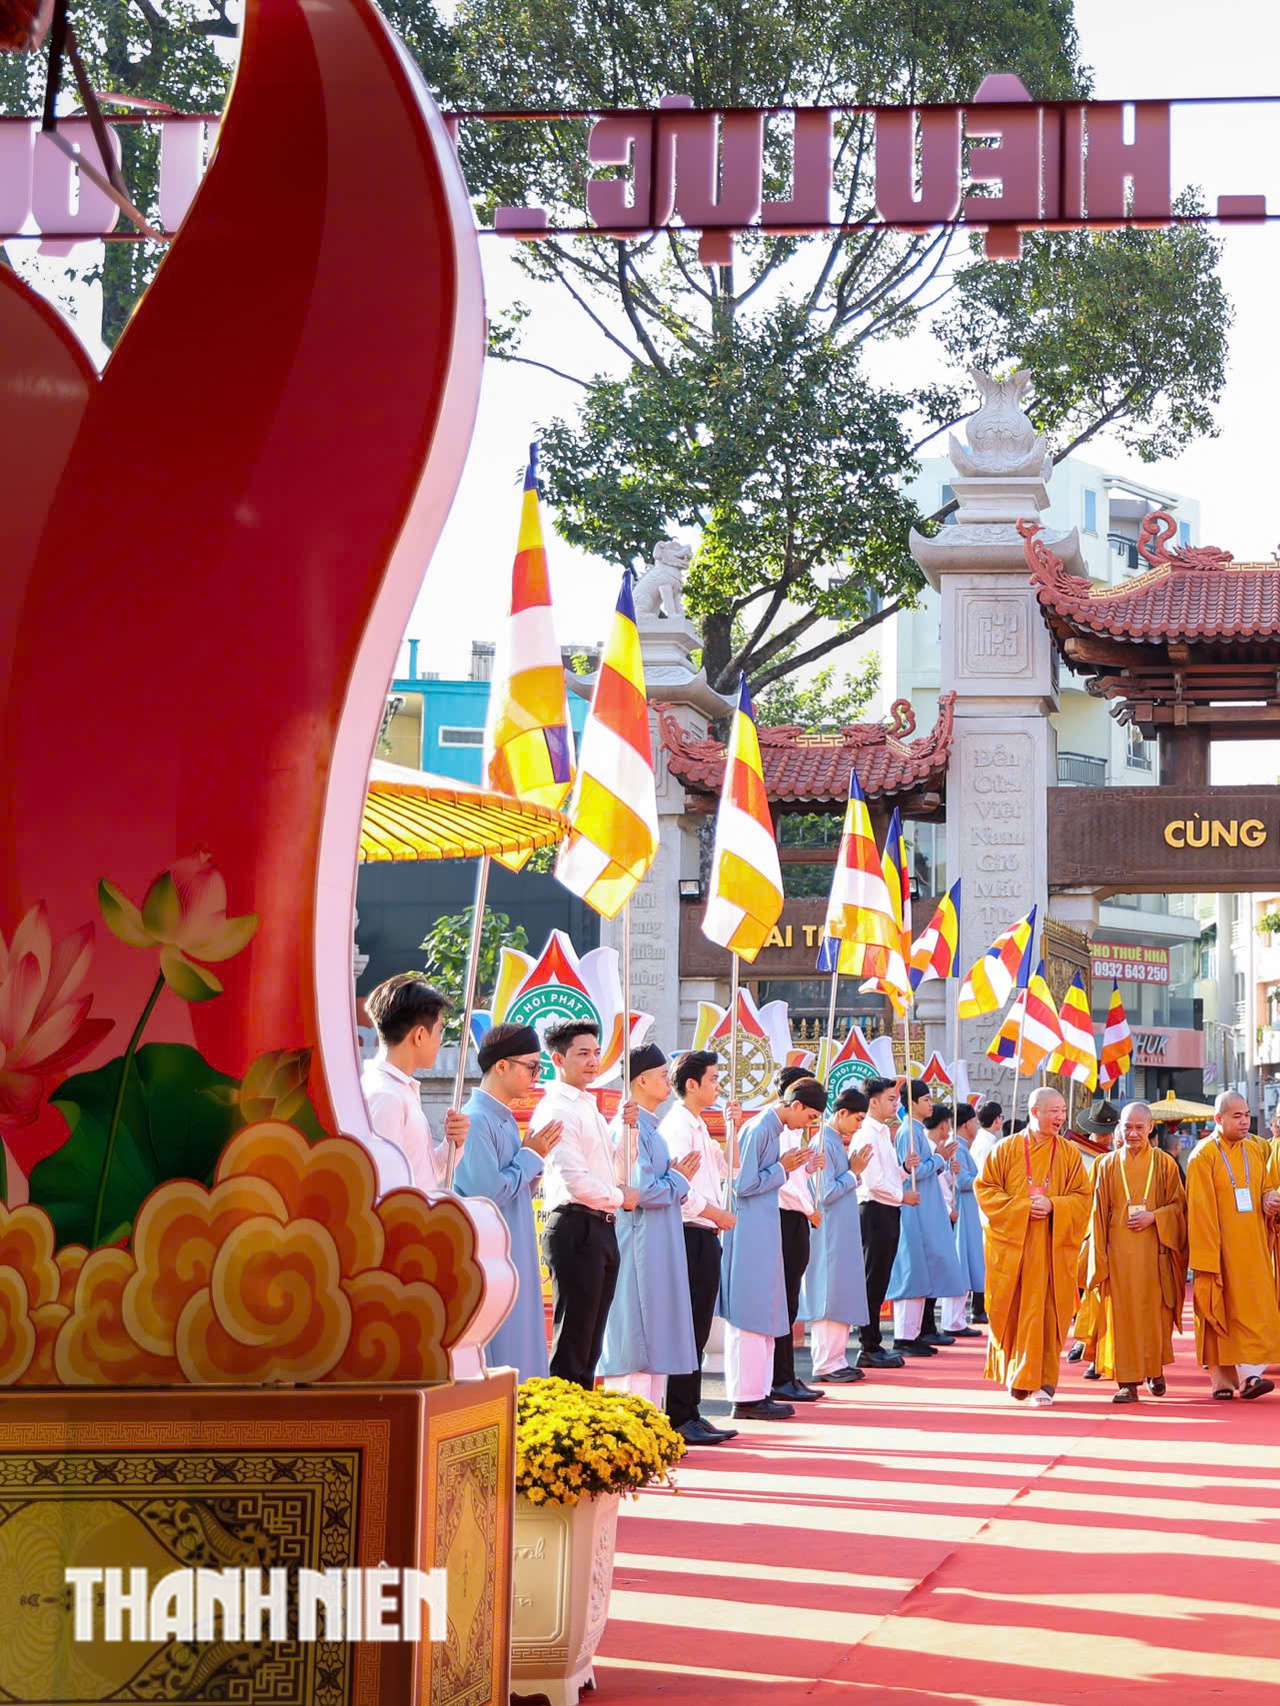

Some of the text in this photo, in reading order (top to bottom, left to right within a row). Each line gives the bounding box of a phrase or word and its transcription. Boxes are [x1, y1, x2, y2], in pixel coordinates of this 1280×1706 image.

[971, 826, 1025, 847] Nam
[1164, 812, 1267, 848] CÙNG
[1112, 946, 1142, 961] THUÊ
[1144, 948, 1168, 964] NHÀ
[1094, 961, 1168, 982] 0932 643 250
